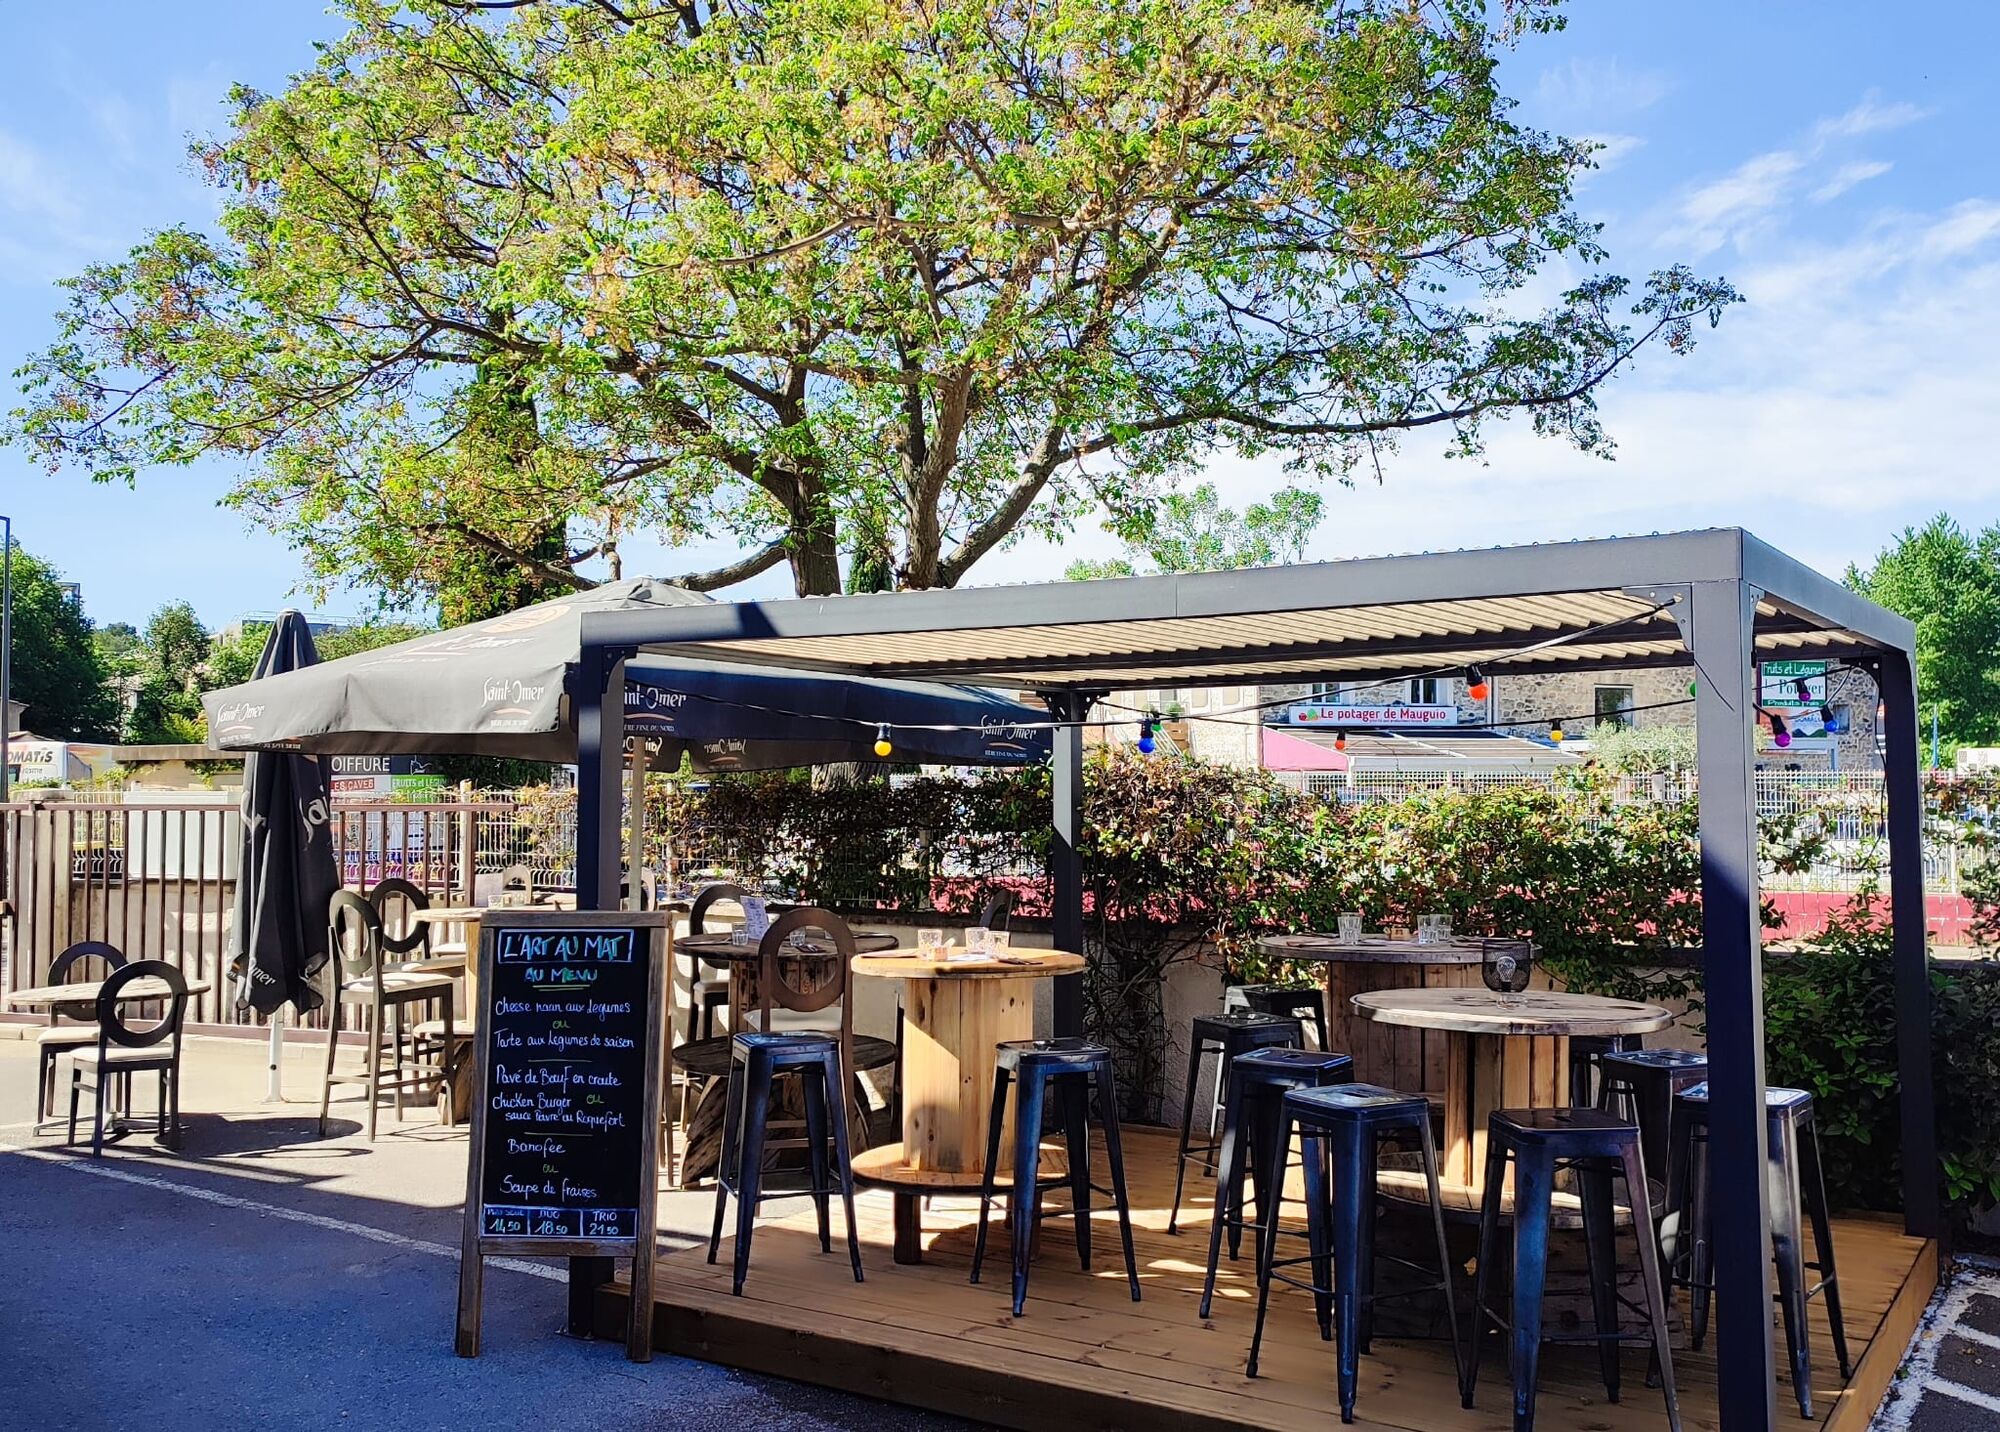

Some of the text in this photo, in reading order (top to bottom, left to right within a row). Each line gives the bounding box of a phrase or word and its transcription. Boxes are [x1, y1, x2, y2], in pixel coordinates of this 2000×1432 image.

[1784, 663, 1793, 674] et
[481, 677, 544, 708] Saint-Omer
[623, 685, 687, 709] int-Omer
[215, 703, 265, 729] Saint-Omer
[1321, 708, 1446, 722] Le potager de Mauguio
[980, 714, 1036, 740] Saint-Omer
[331, 757, 390, 772] OIFFURE
[334, 781, 346, 790] ES
[504, 934, 624, 961] L'ART AU MAT
[524, 967, 598, 983] AU MENU
[565, 1002, 585, 1013] aux
[552, 1019, 571, 1029] ou
[494, 1028, 522, 1048] Tarte
[527, 1036, 546, 1046] aux
[590, 1034, 601, 1047] de
[603, 1036, 634, 1048] saison
[524, 1068, 538, 1084] de
[572, 1073, 585, 1084] en
[537, 1092, 572, 1115] Burger
[586, 1094, 605, 1105] ou
[505, 1111, 532, 1122] sauce
[576, 1109, 626, 1133] Roquefort
[507, 1138, 567, 1158] Banofee
[499, 1174, 598, 1202] Soupe de fraises
[592, 1210, 618, 1222] TRIO
